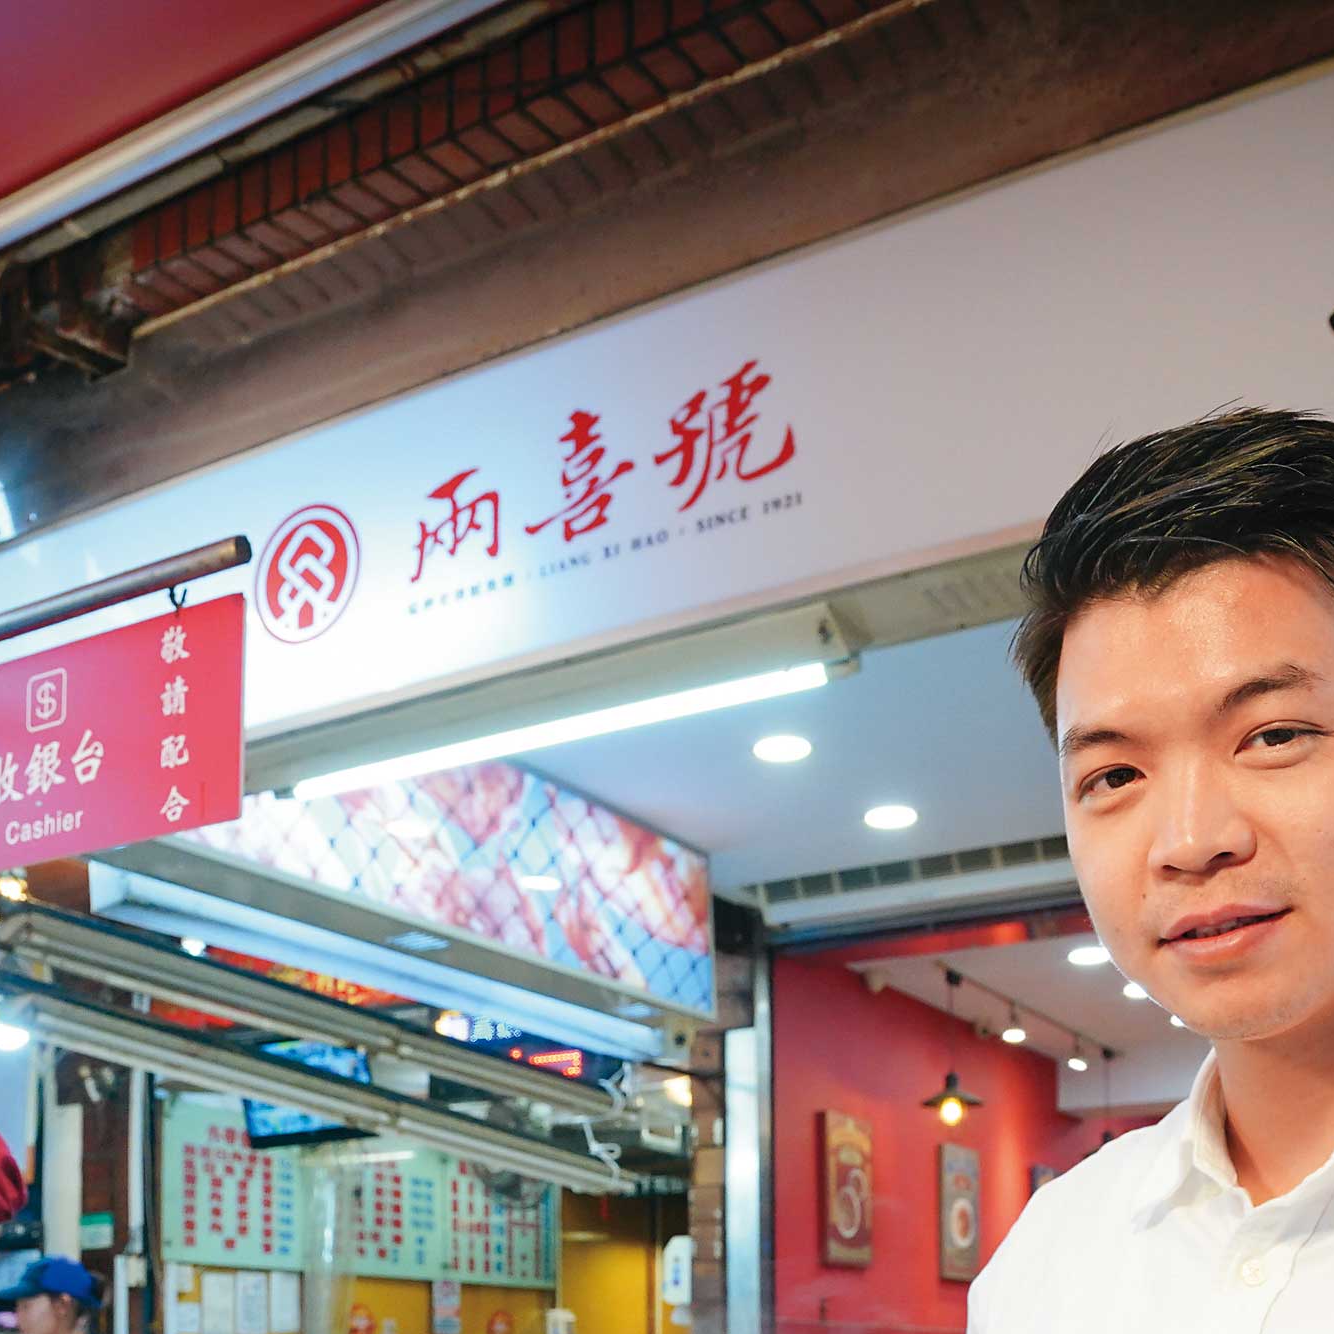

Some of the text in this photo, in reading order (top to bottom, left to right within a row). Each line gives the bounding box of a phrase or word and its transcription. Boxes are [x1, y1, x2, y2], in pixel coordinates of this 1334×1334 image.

[410, 359, 796, 582] 兩喜號
[694, 506, 750, 535] SINCE
[761, 491, 804, 516] 1921
[159, 625, 192, 823] 敬請配合
[5, 808, 84, 846] Cashier
